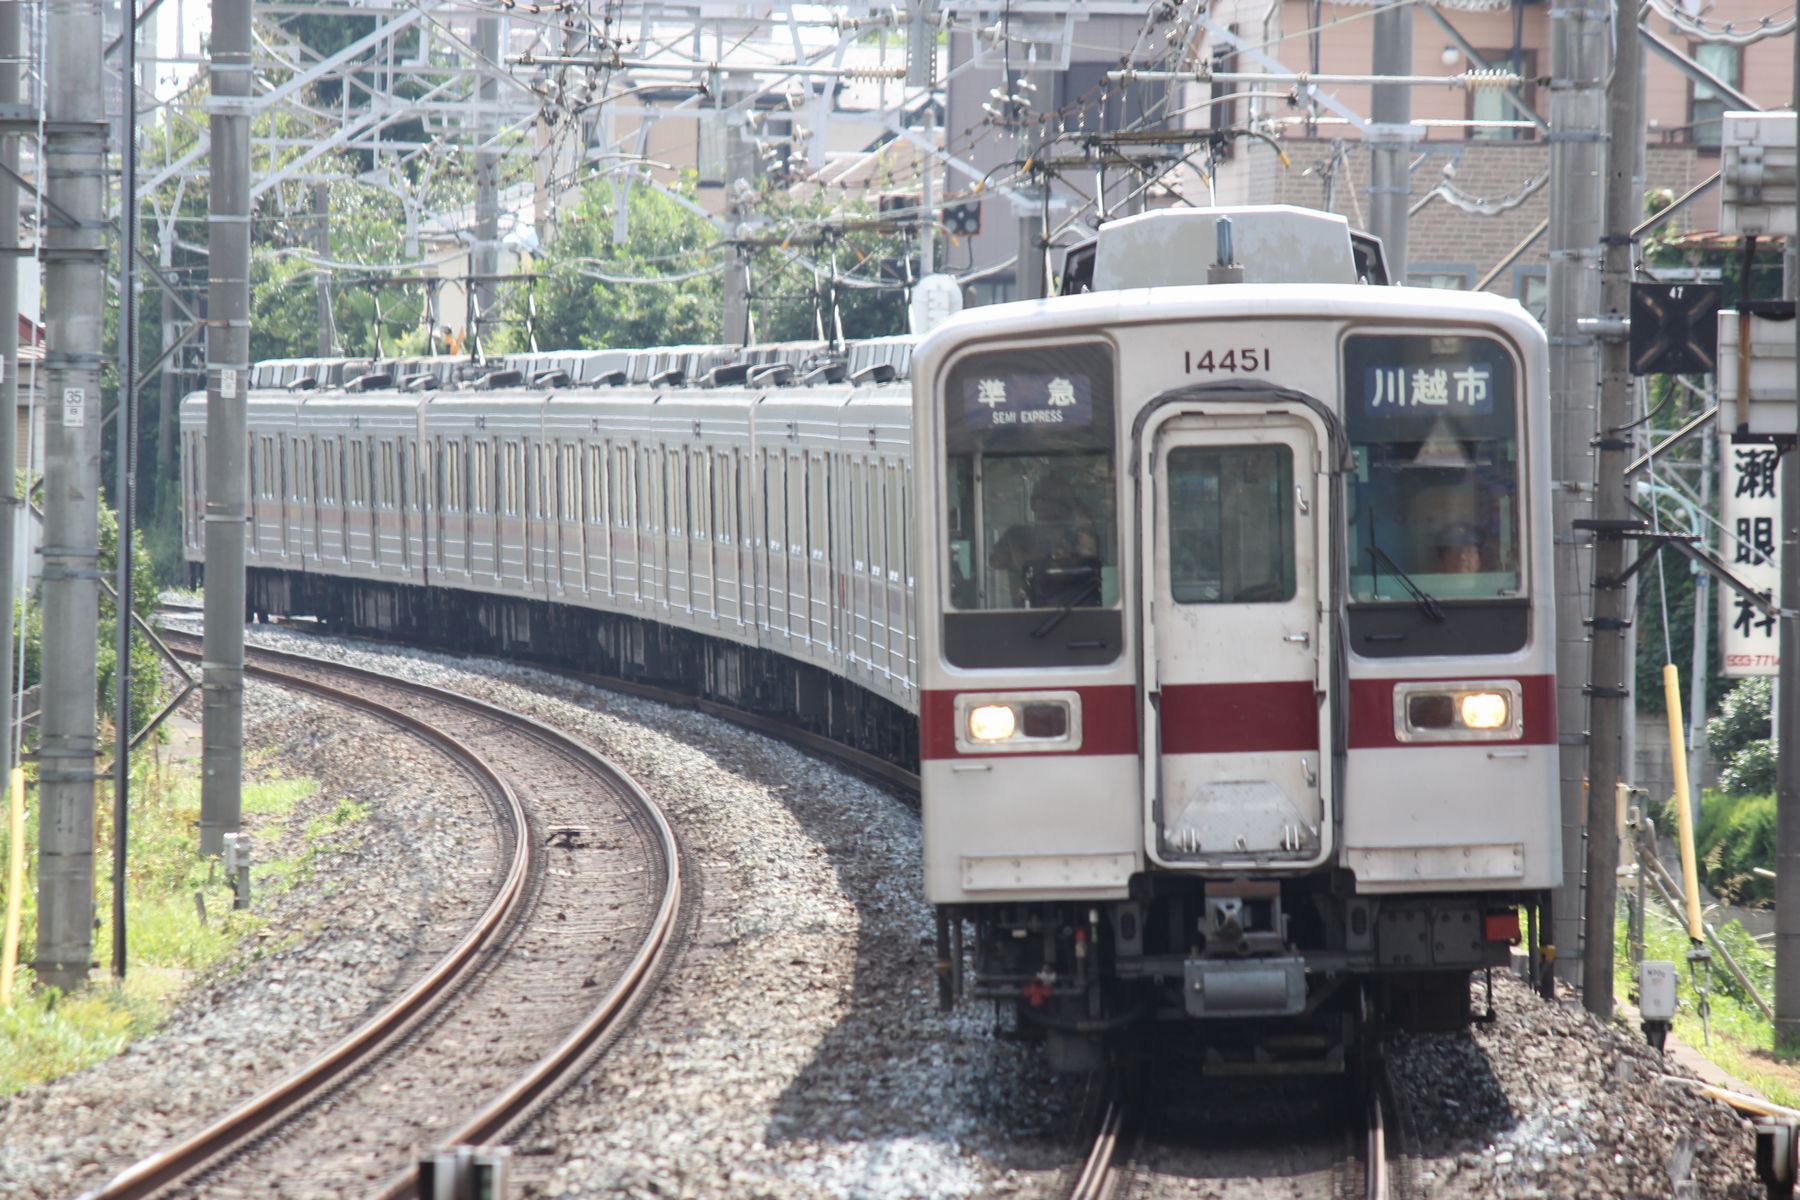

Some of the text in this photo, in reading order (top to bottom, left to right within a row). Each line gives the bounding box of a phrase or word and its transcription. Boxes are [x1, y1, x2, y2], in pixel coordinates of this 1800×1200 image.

[1668, 286, 1684, 299] 47
[1184, 347, 1270, 374] 14451
[1371, 366, 1490, 407] 川越市
[66, 390, 82, 404] 35
[992, 410, 1064, 424] SEMI EXPRESS
